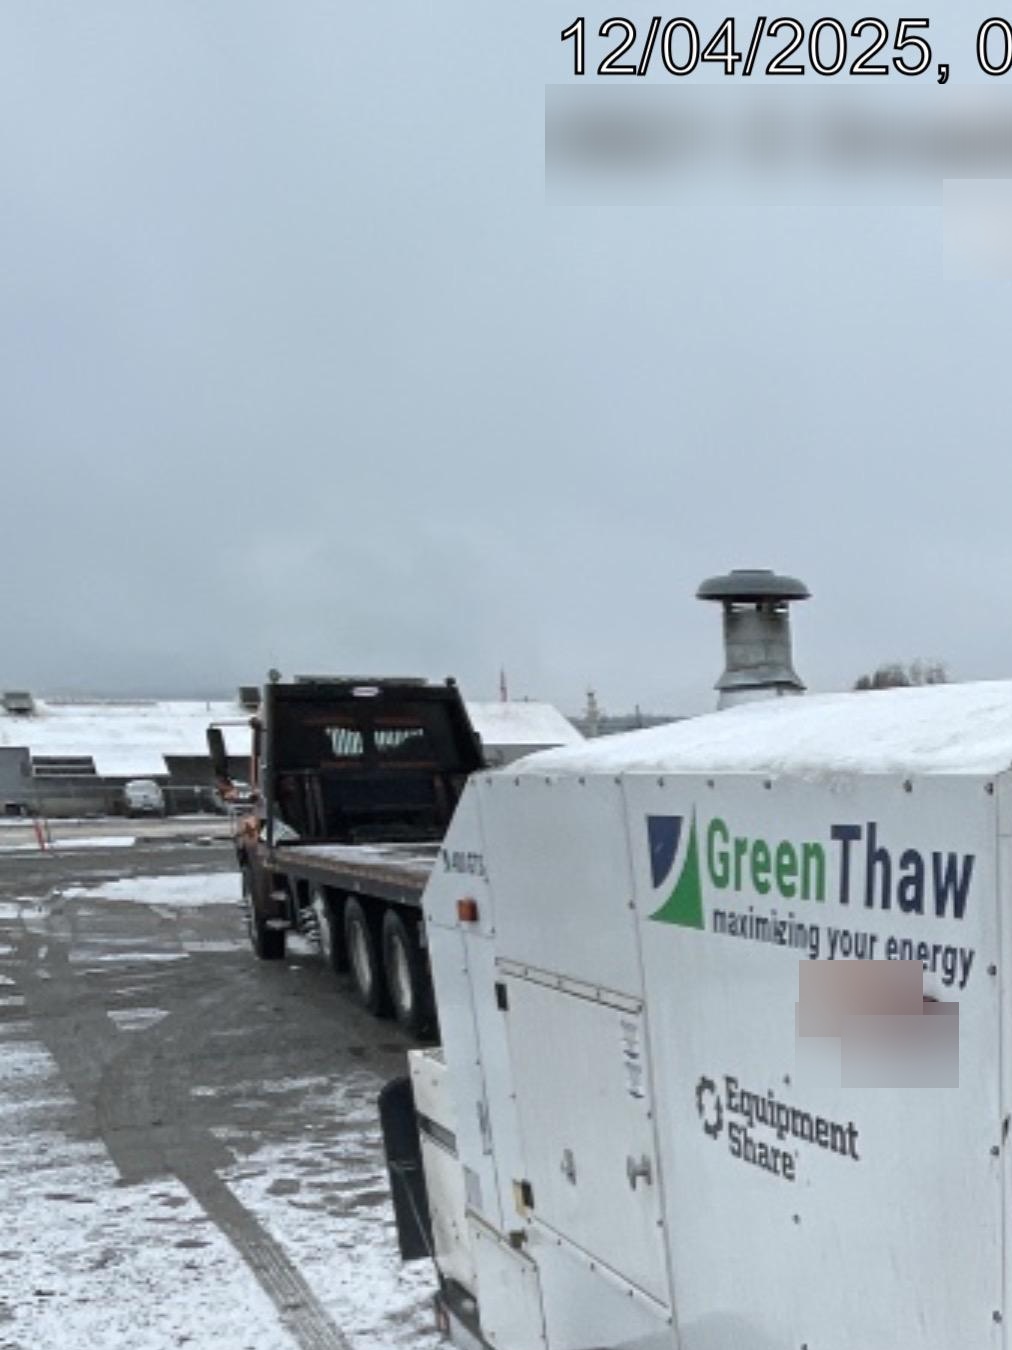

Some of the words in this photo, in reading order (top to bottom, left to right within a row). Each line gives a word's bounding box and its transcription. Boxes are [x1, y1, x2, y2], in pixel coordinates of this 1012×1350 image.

[713, 906, 820, 960] maximizing
[826, 926, 878, 961] your
[884, 935, 976, 990] energy
[724, 1075, 861, 1162] Equipment
[727, 1121, 796, 1182] Share
